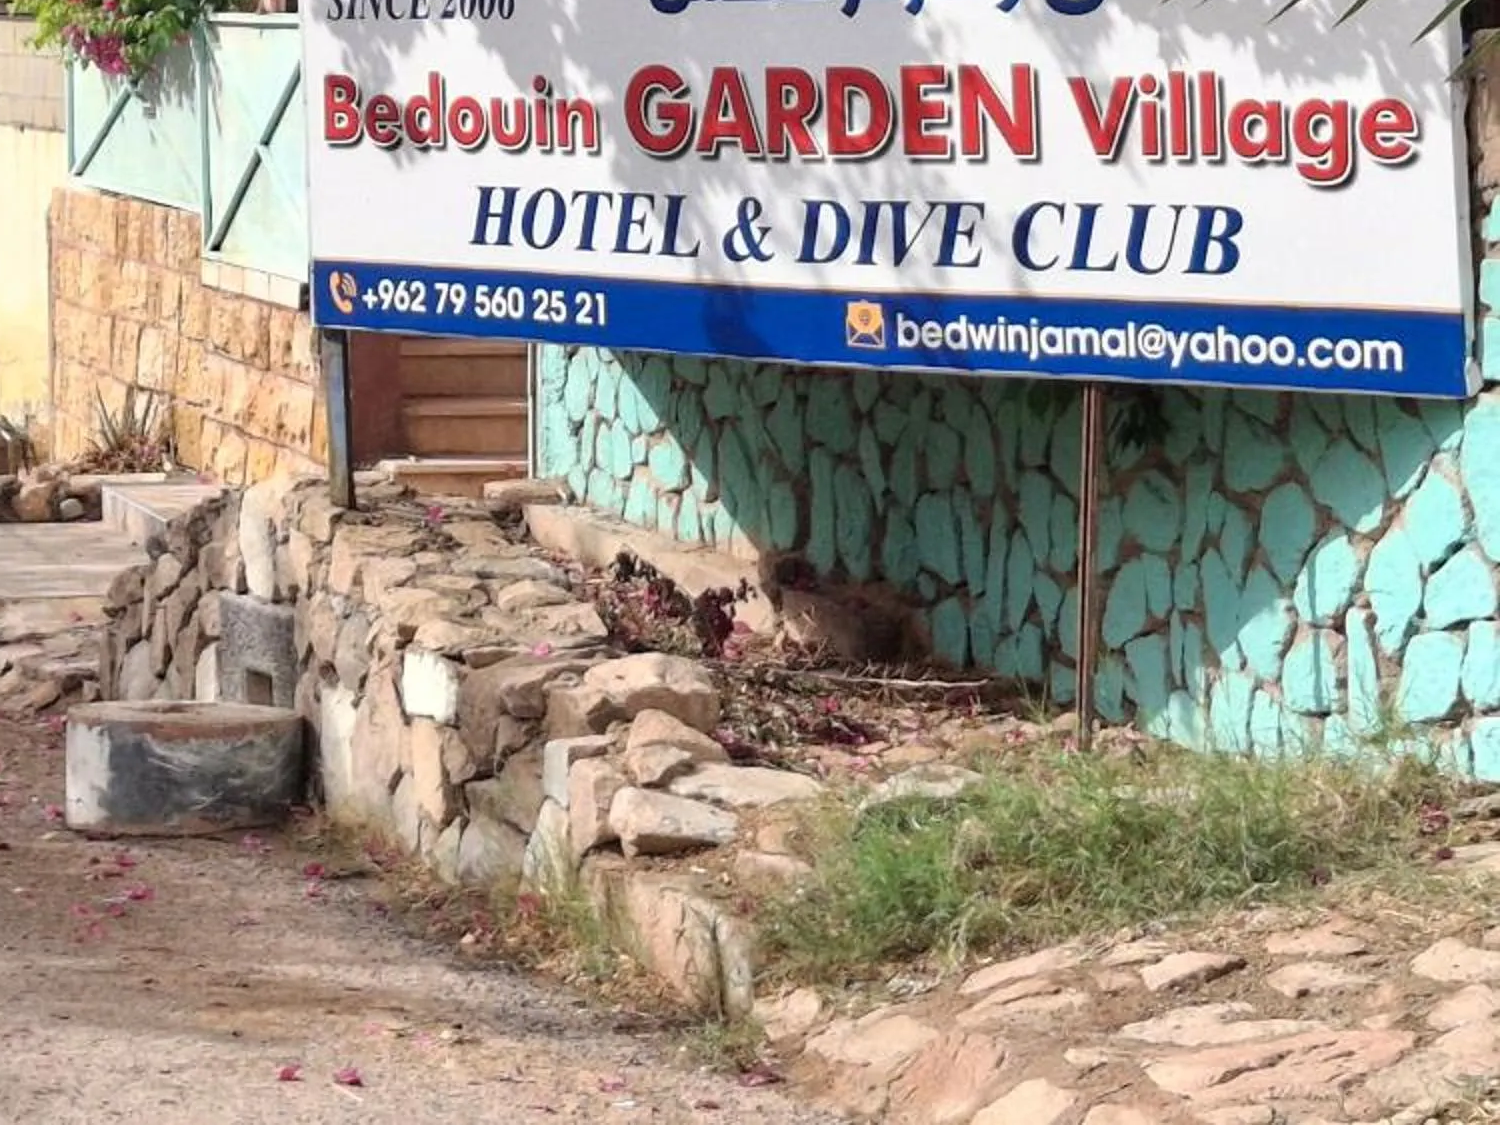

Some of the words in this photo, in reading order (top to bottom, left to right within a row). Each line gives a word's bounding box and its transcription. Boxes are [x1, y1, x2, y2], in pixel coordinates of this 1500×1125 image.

[322, 71, 598, 152] Bedouin
[624, 63, 1037, 159] GARDEN
[1067, 69, 1419, 183] Village
[469, 185, 701, 258] HOTEL
[722, 195, 776, 263] &
[793, 198, 985, 268] DIVE
[1011, 201, 1245, 276] CLUB
[362, 277, 426, 313] +962
[433, 281, 466, 316] 79
[473, 286, 525, 320] 560
[531, 289, 568, 323] 25
[574, 292, 608, 326] 21
[896, 313, 1404, 372] bedwinjamal@yahoo.com
